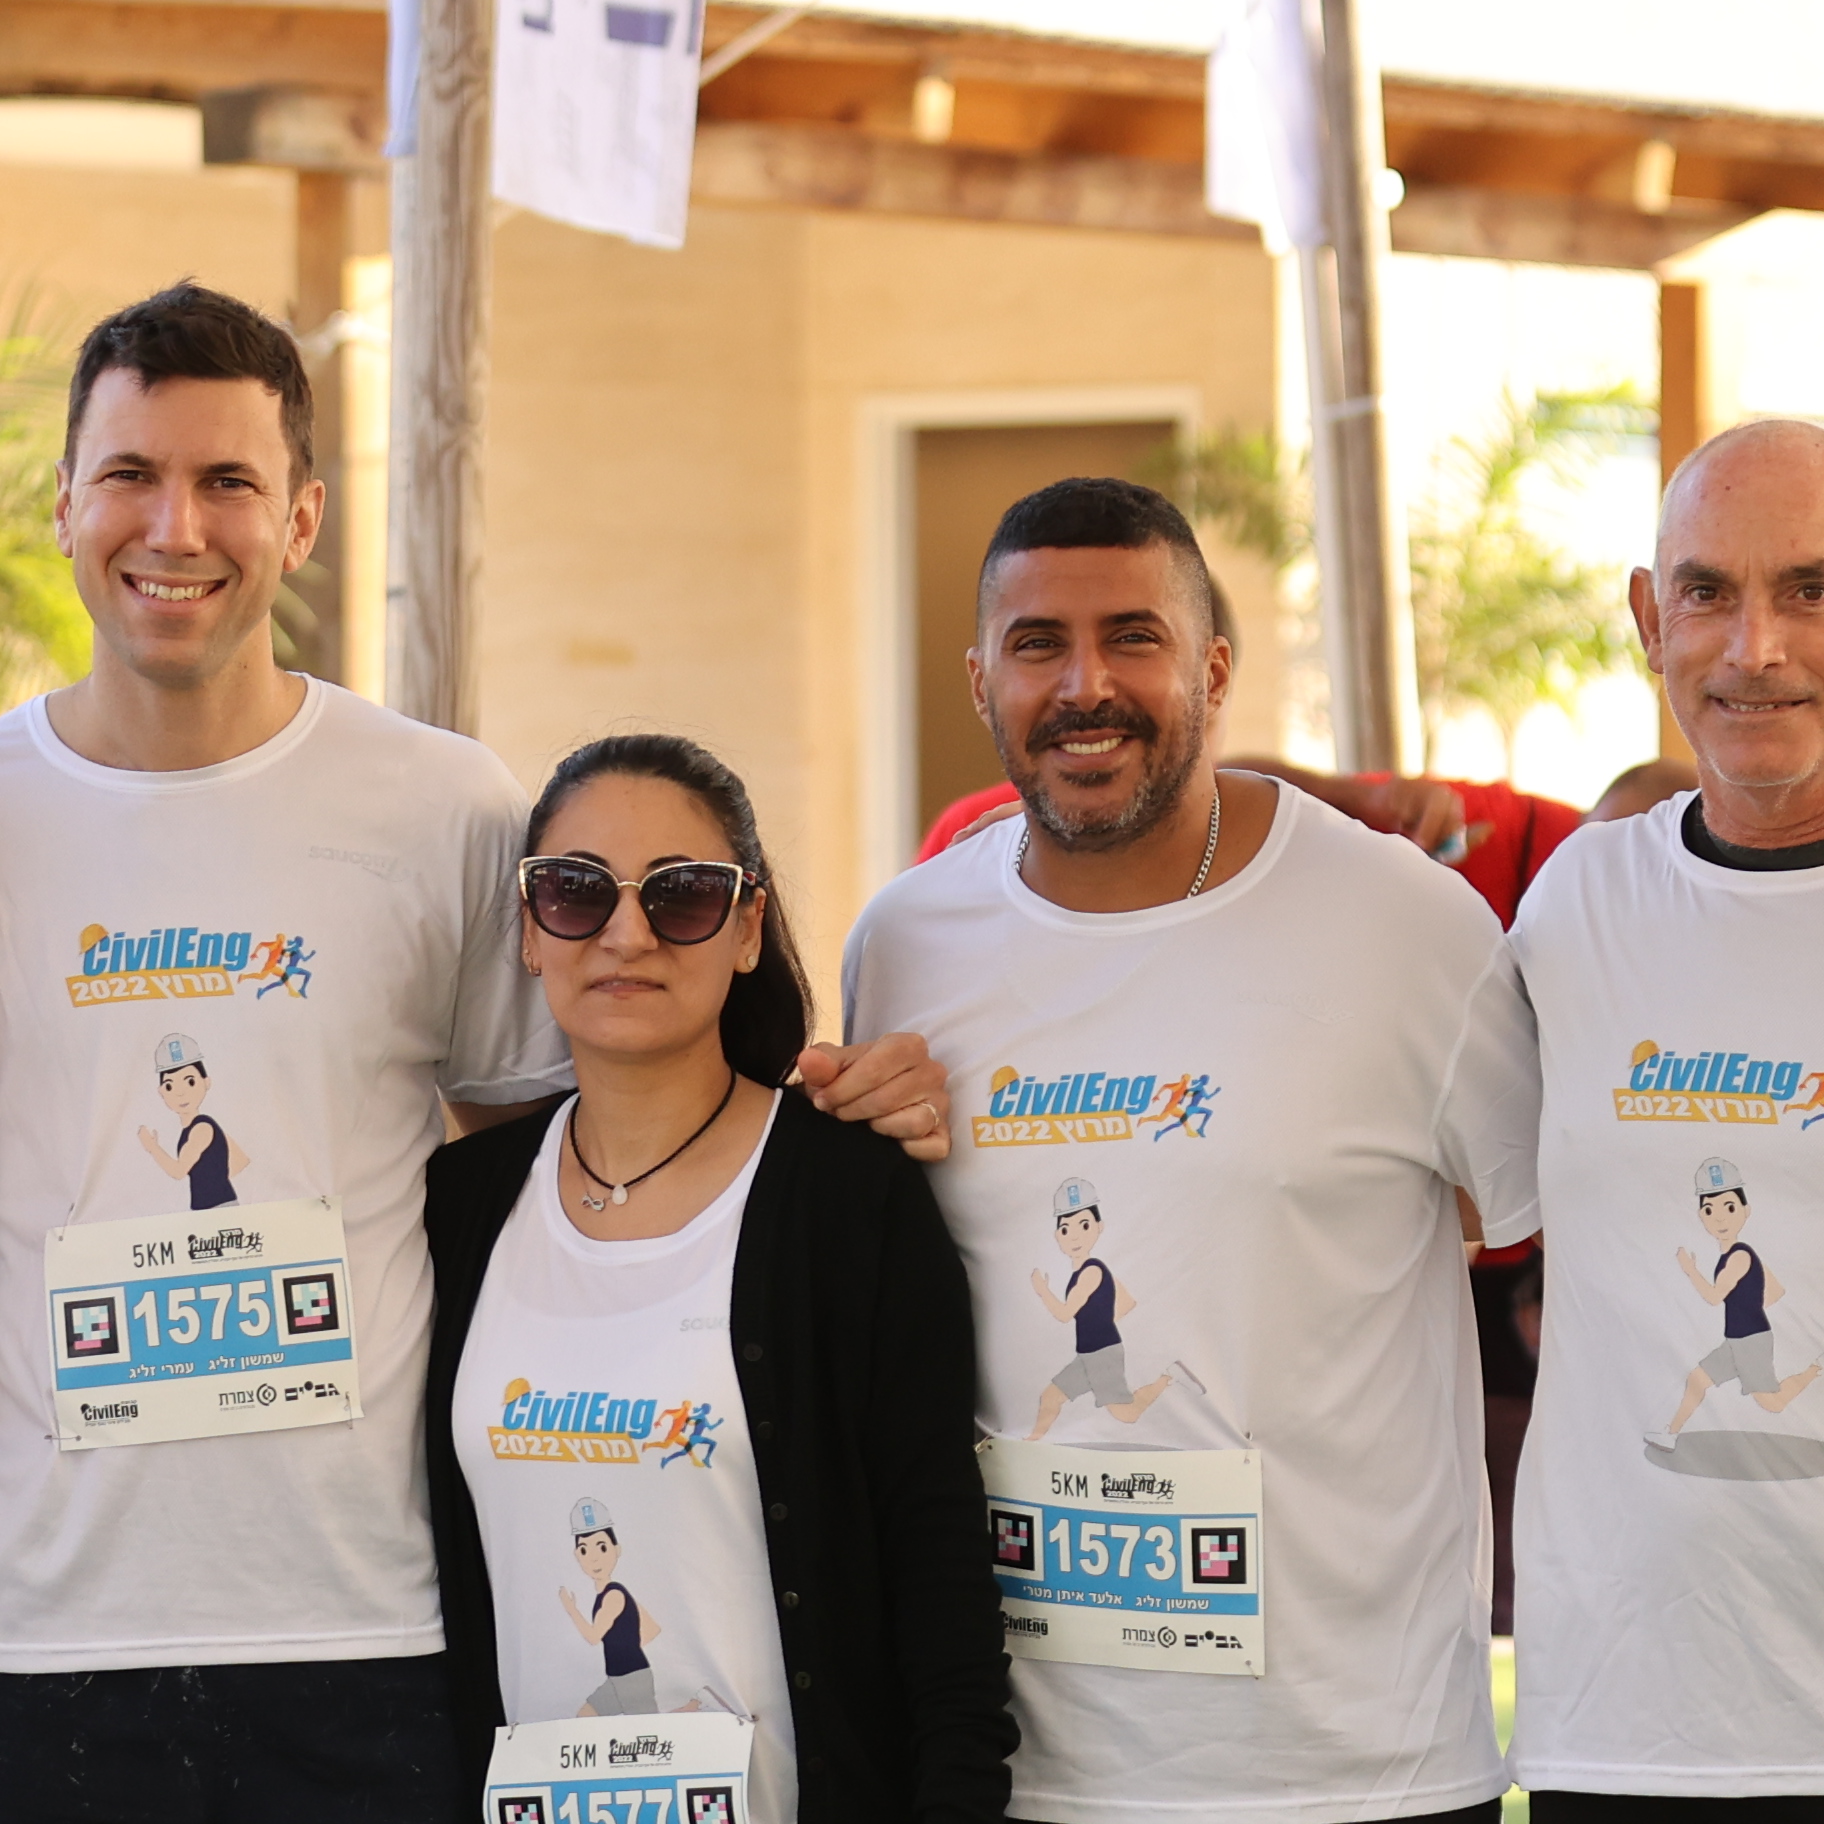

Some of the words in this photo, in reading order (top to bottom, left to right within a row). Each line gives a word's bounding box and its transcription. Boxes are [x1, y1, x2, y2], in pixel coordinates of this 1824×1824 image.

[83, 926, 252, 976] CivilEng
[72, 976, 149, 1002] 2022
[151, 972, 227, 999] מרוץ
[1630, 1051, 1803, 1101] CivilEng
[989, 1072, 1157, 1118] CivilEng
[1619, 1095, 1692, 1117] 2022
[1694, 1096, 1772, 1122] מרוץ
[976, 1121, 1052, 1144] 2022
[1053, 1116, 1125, 1143] מרוץ
[132, 1241, 175, 1268] 5KM
[132, 1279, 271, 1347] 1575
[129, 1365, 157, 1379] זליג
[161, 1361, 196, 1375] עמרי
[208, 1356, 236, 1371] זליג
[241, 1352, 285, 1370] שמשון
[219, 1390, 255, 1407] צמרת
[83, 1402, 139, 1421] CivilEng
[502, 1390, 658, 1440] CivilEng
[492, 1433, 563, 1457] 2022
[563, 1437, 633, 1464] מרוץ
[1051, 1471, 1089, 1498] 5KM
[1048, 1518, 1177, 1581] 1573
[1023, 1585, 1053, 1600] מטרי
[1056, 1590, 1085, 1603] איתן
[1088, 1592, 1122, 1605] אלעד
[1135, 1595, 1162, 1608] זליג
[1165, 1596, 1210, 1612] שמשון
[1122, 1628, 1156, 1641] צמרת
[560, 1743, 597, 1769] 5KM
